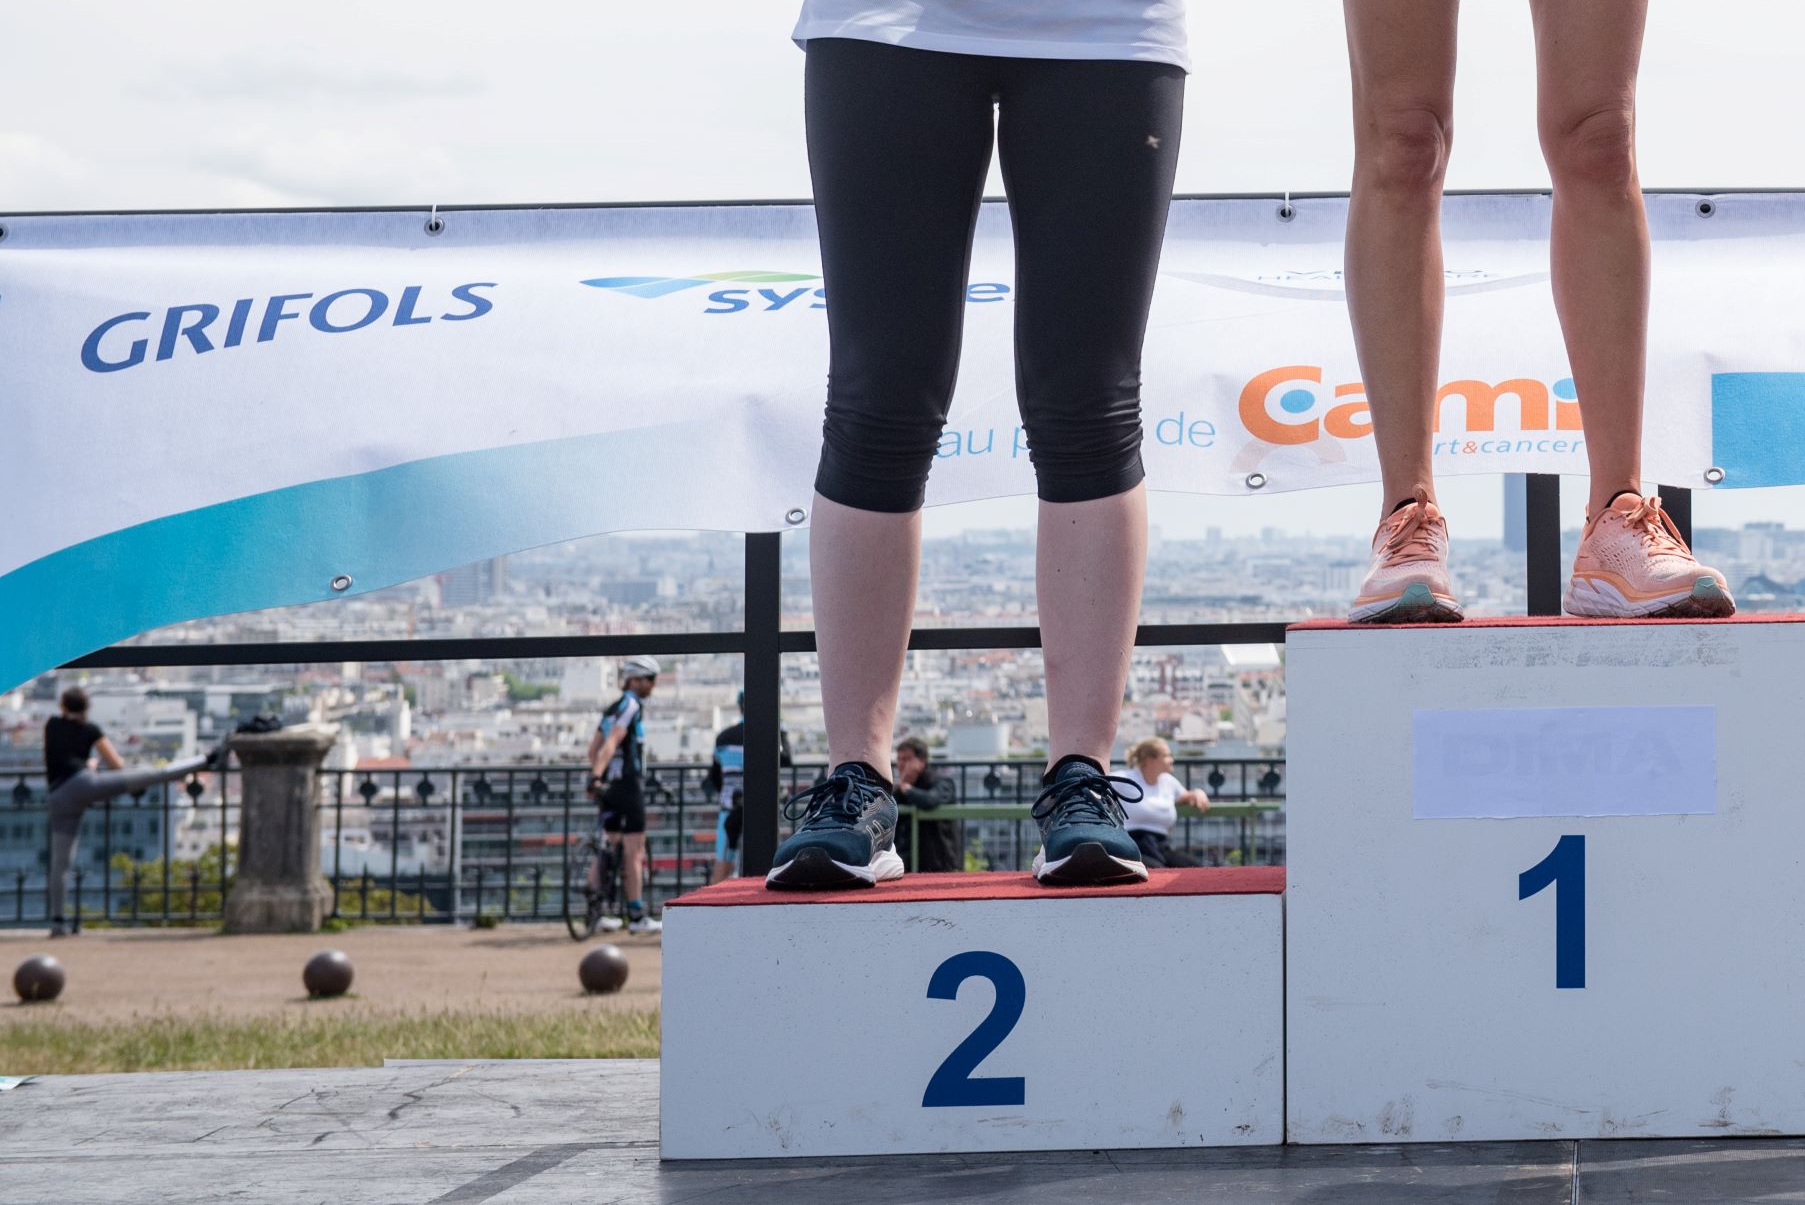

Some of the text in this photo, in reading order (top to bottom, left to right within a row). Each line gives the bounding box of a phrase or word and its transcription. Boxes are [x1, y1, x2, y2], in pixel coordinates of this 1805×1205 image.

[80, 282, 499, 374] GRIFOLS
[937, 427, 993, 459] au
[1155, 411, 1216, 448] de
[1518, 834, 1586, 989] 1
[921, 950, 1027, 1108] 2
